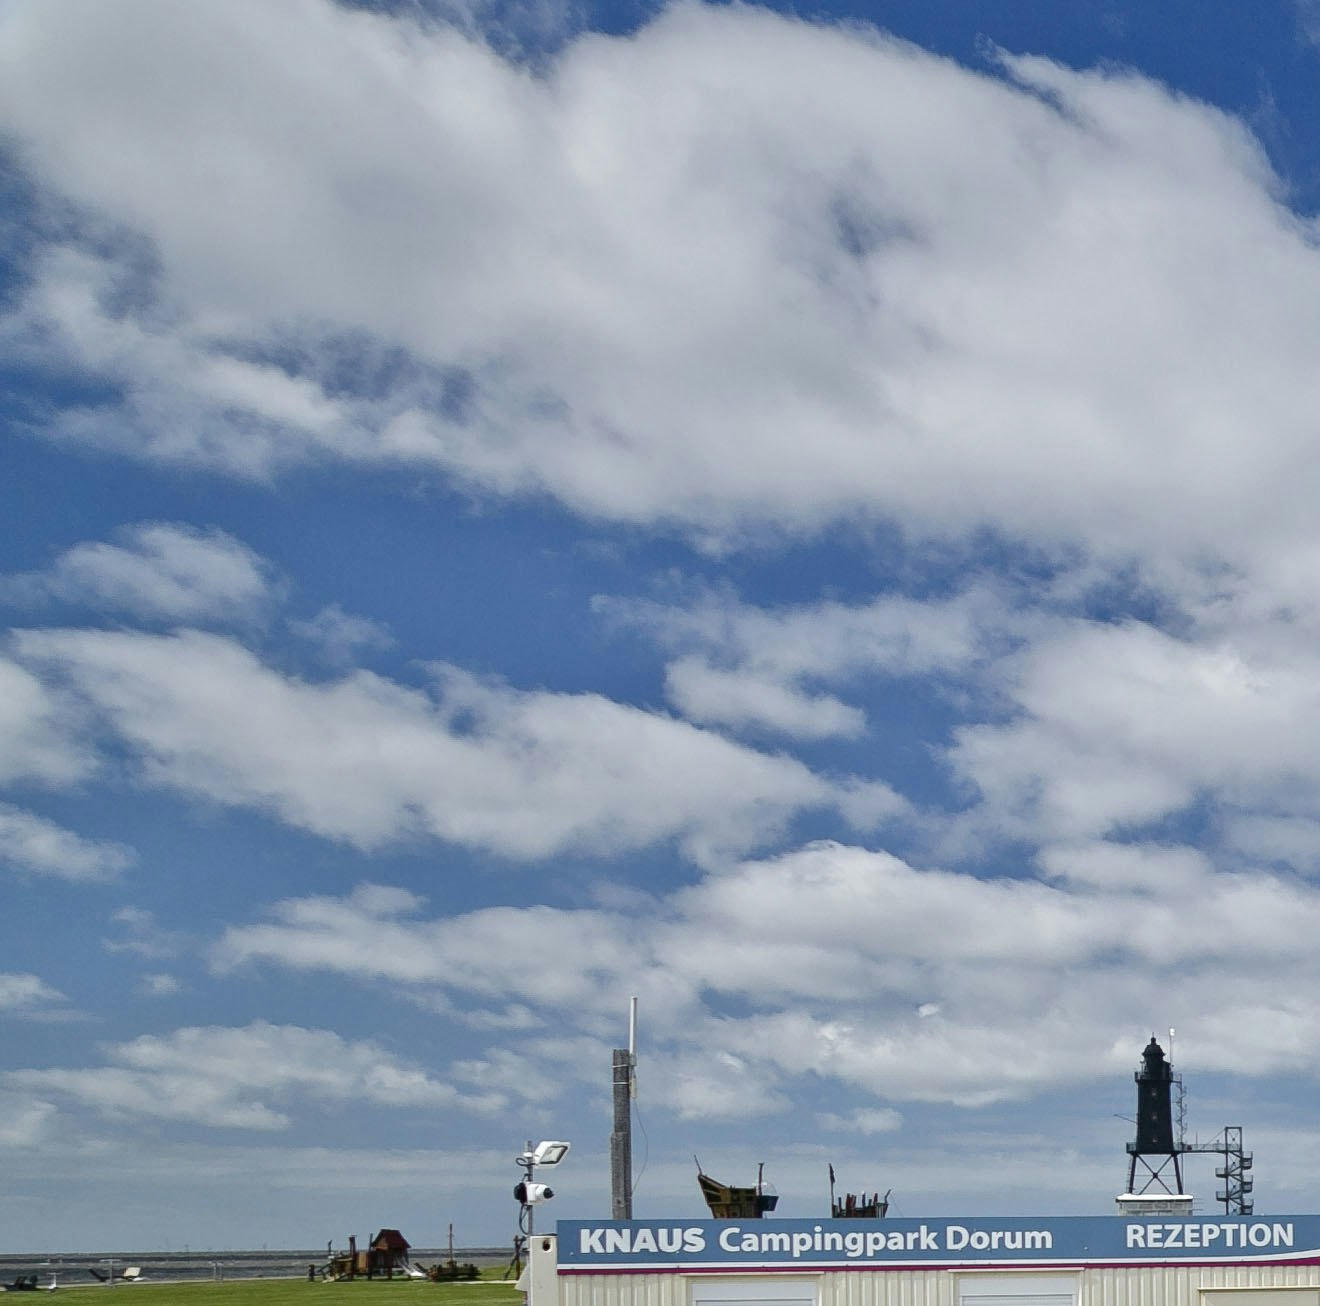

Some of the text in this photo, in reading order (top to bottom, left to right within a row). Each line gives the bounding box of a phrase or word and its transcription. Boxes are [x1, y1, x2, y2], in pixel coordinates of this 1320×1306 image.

[580, 1225, 1052, 1258] KNAUS Campingpark Dorum
[1126, 1222, 1294, 1249] REZEPTION
